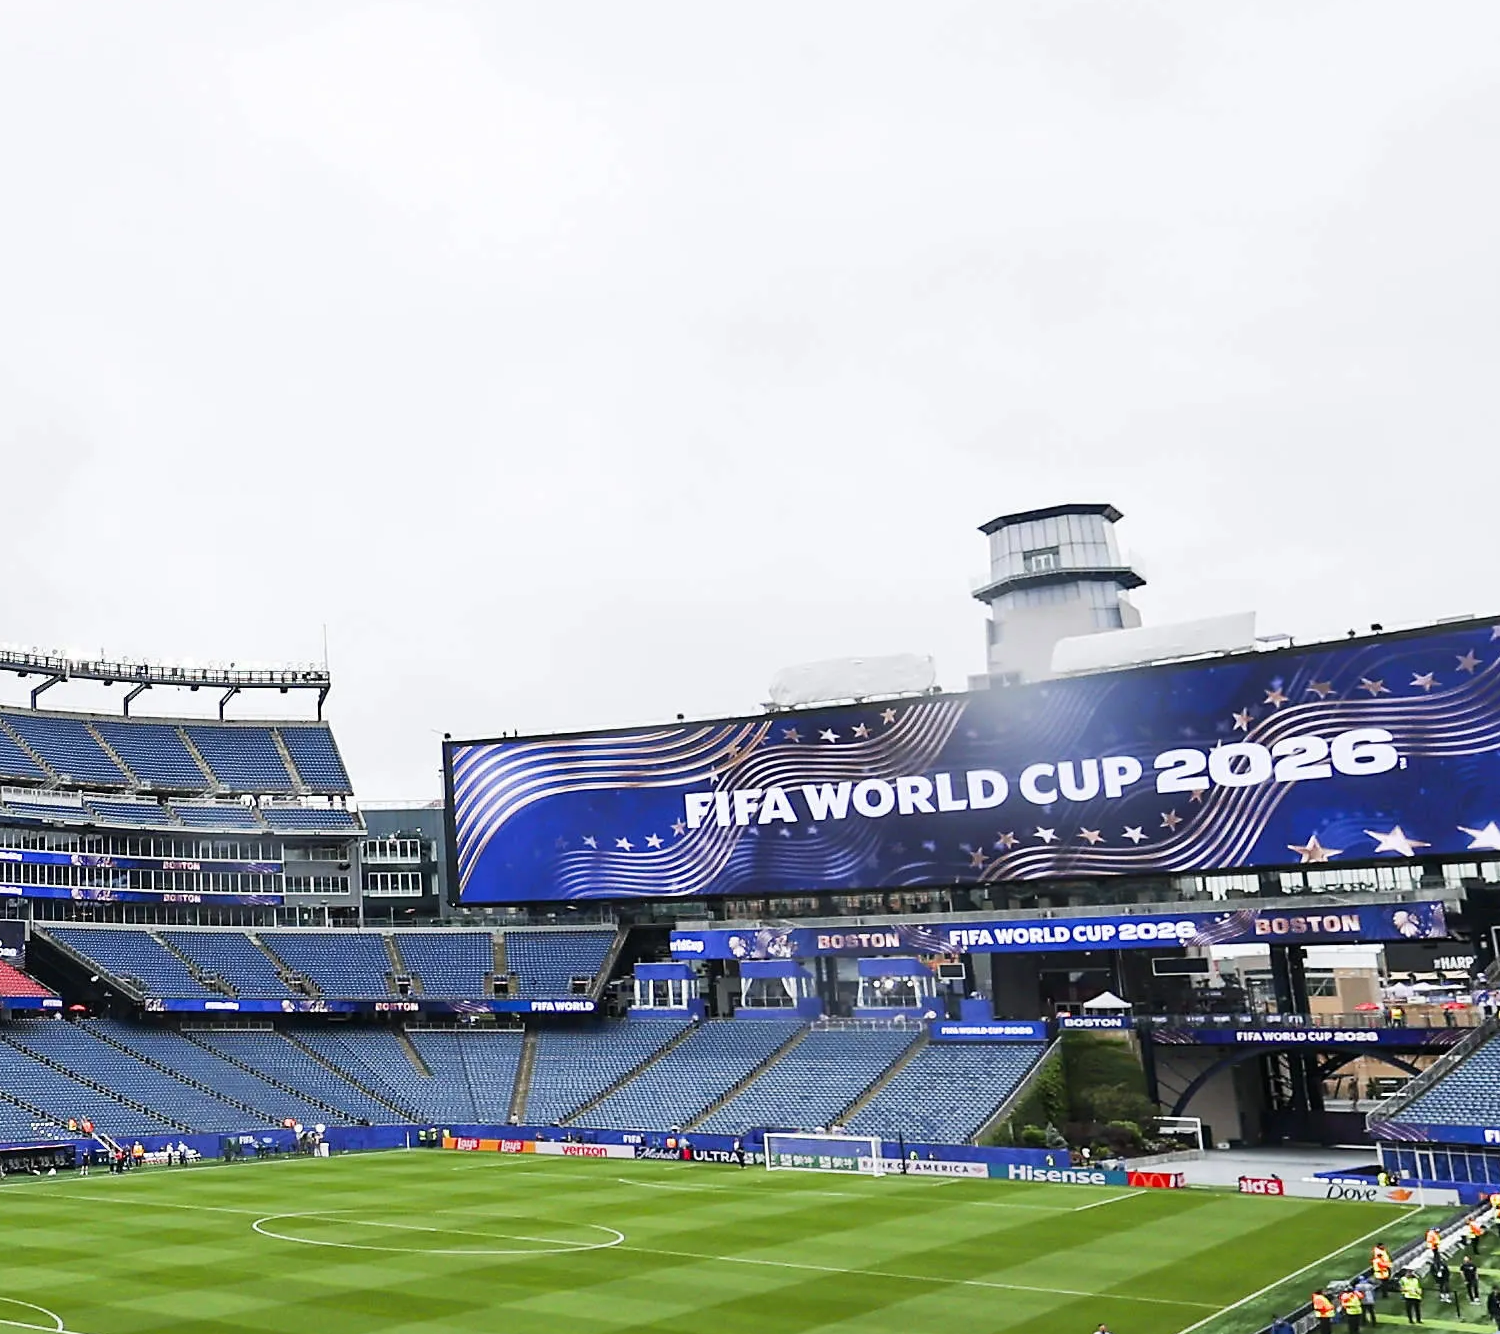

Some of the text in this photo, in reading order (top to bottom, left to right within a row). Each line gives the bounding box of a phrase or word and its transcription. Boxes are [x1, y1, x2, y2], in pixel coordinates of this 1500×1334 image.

[683, 727, 1402, 828] FIFA WORLD CUP 2026
[1255, 915, 1360, 935] BOSTON
[817, 933, 900, 949] BOSTON
[950, 921, 1197, 947] FIFA WORLD CUP 2026
[531, 1001, 594, 1011] FIFA WORLD
[1064, 1019, 1122, 1028] BOSTON
[1236, 1032, 1379, 1041] FIFA WORLD CUP 2026
[562, 1145, 608, 1157] verizon
[693, 1150, 740, 1163] ULTRA
[912, 1162, 969, 1173] AMERICA
[1008, 1164, 1106, 1185] Hisense
[1327, 1184, 1378, 1202] Dove
